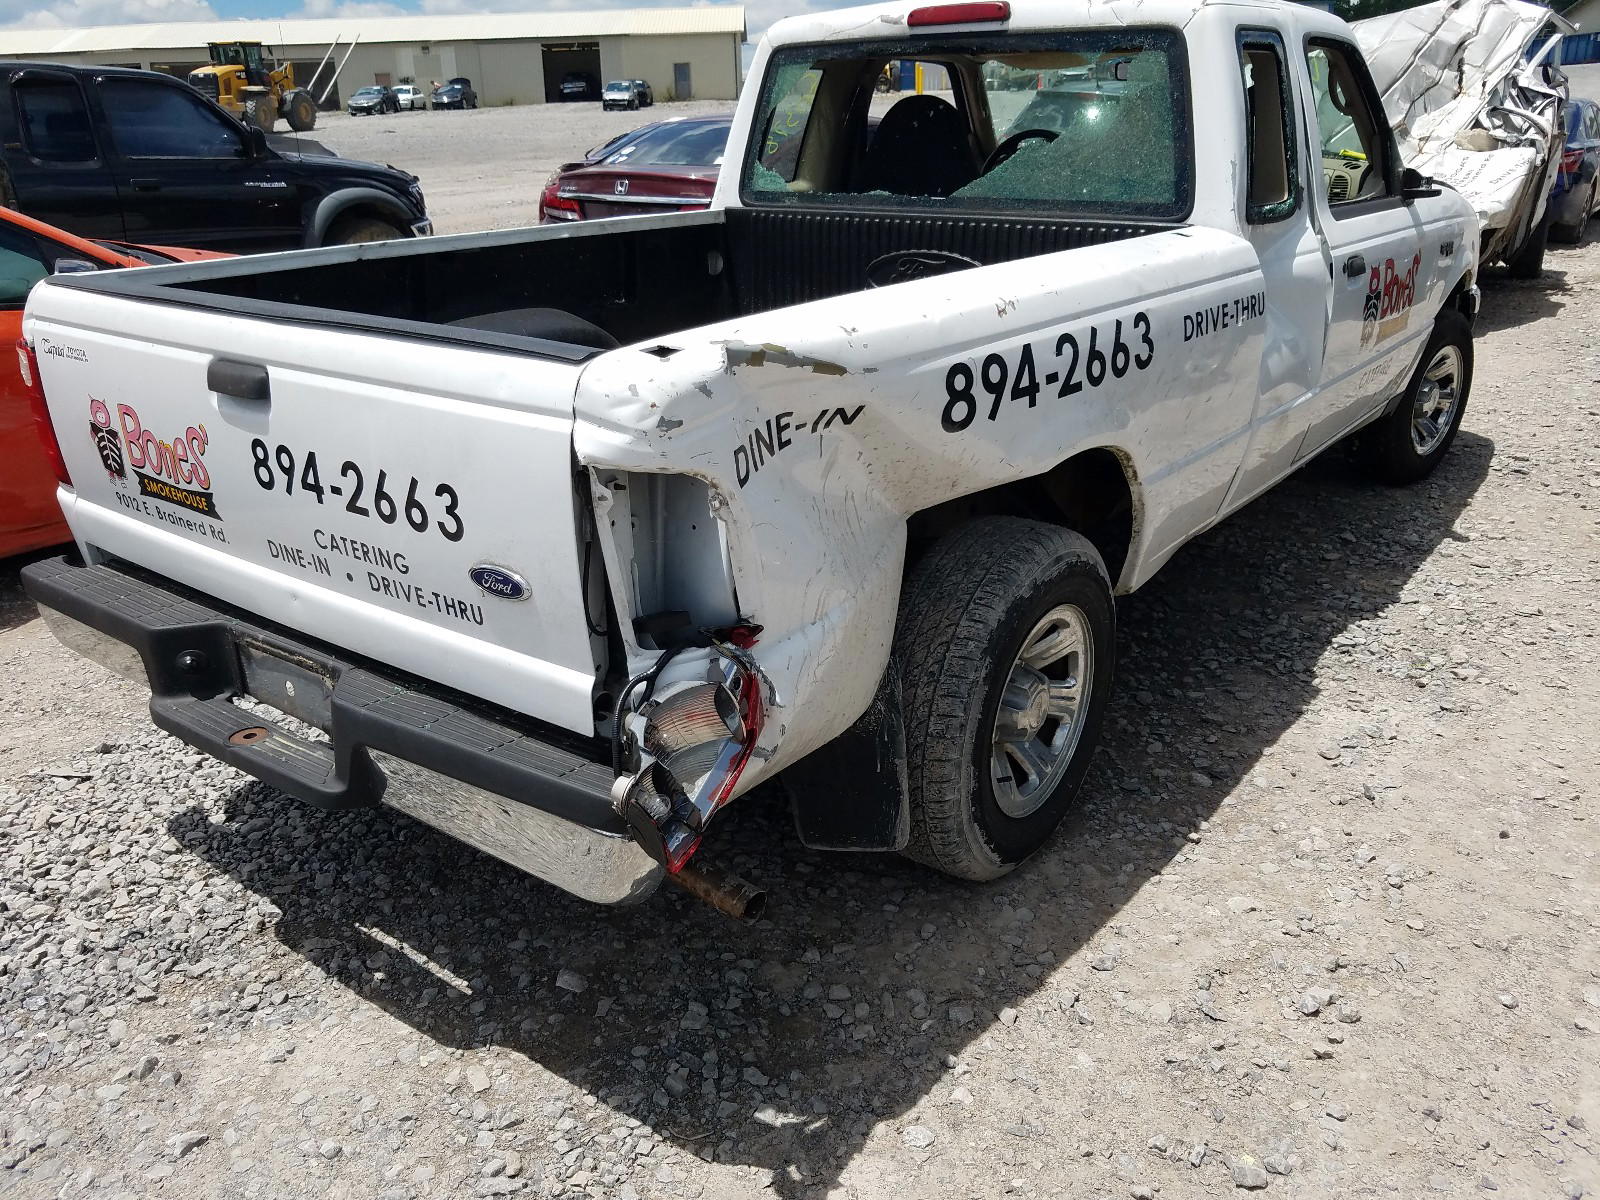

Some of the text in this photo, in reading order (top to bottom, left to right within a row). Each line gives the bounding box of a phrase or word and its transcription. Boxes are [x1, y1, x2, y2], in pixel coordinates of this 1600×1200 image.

[1183, 291, 1266, 343] DRIVE-THRU
[940, 311, 1155, 434] 894-2663
[116, 402, 211, 491] Bones'
[734, 404, 866, 489] DINE-IN
[115, 491, 231, 545] 9012 E. Brainerd Rd.
[144, 478, 209, 511] SMOKEHOUSE
[251, 438, 465, 543] 894-2663
[266, 539, 485, 626] DINE-IN DRIVE-THRU
[313, 529, 410, 575] CATERING
[481, 571, 514, 595] Ford
